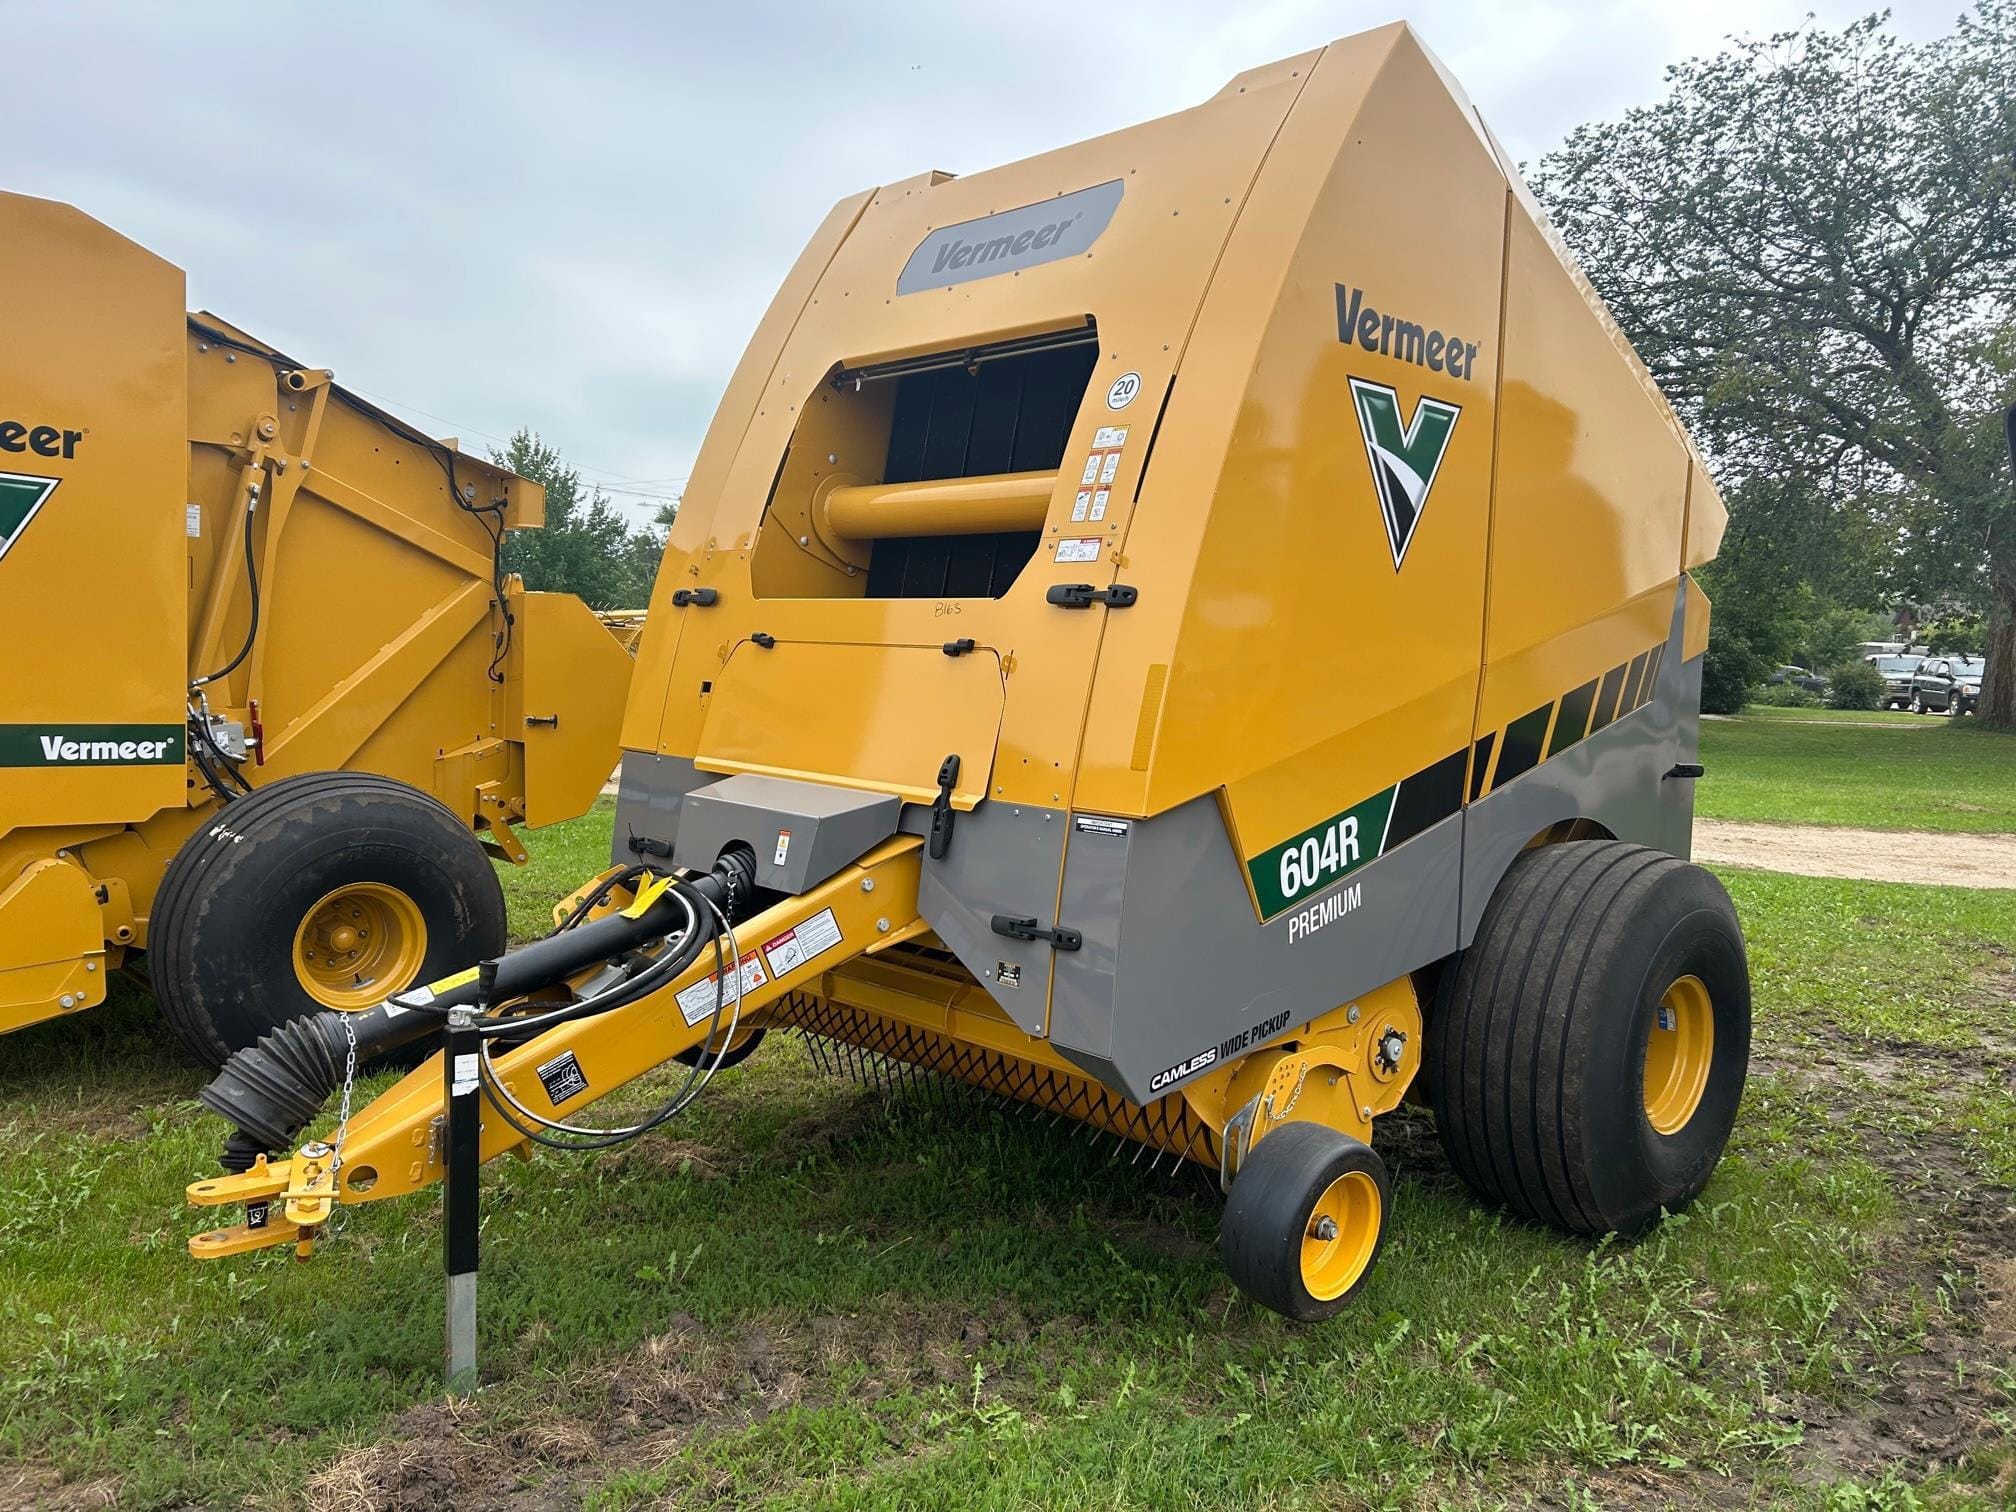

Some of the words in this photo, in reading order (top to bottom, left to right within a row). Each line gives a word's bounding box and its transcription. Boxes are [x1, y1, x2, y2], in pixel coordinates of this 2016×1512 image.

[931, 218, 1075, 274] Vermeer
[1334, 281, 1478, 382] Vermeer
[1113, 379, 1135, 397] 20
[39, 735, 168, 761] Vermeer
[1279, 815, 1361, 898] 604R
[1288, 881, 1362, 945] PREMIUM
[1151, 1048, 1217, 1091] CAMLESS
[1220, 1030, 1250, 1060] WIDE
[1250, 1009, 1291, 1045] PICKUP
